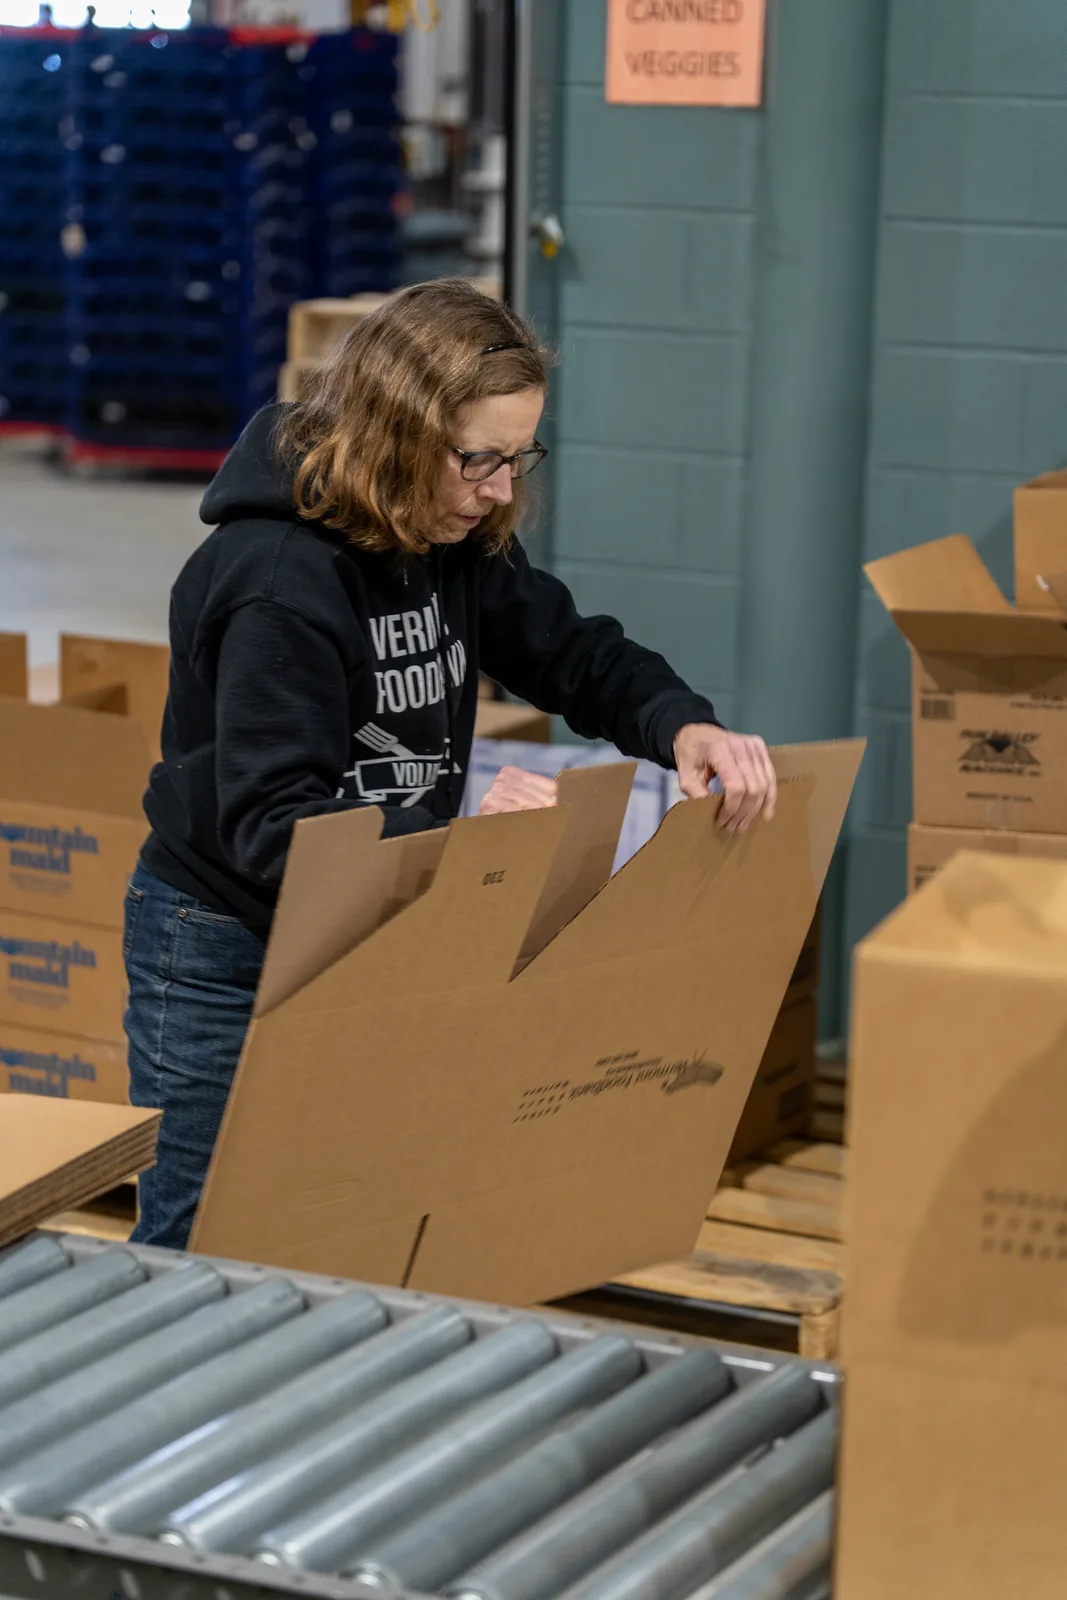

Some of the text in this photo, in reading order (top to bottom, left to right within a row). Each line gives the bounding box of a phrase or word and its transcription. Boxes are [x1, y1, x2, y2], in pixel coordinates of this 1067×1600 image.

[626, 0, 744, 25] CANNED
[624, 51, 742, 79] VEGGIES
[369, 592, 441, 660] VERM
